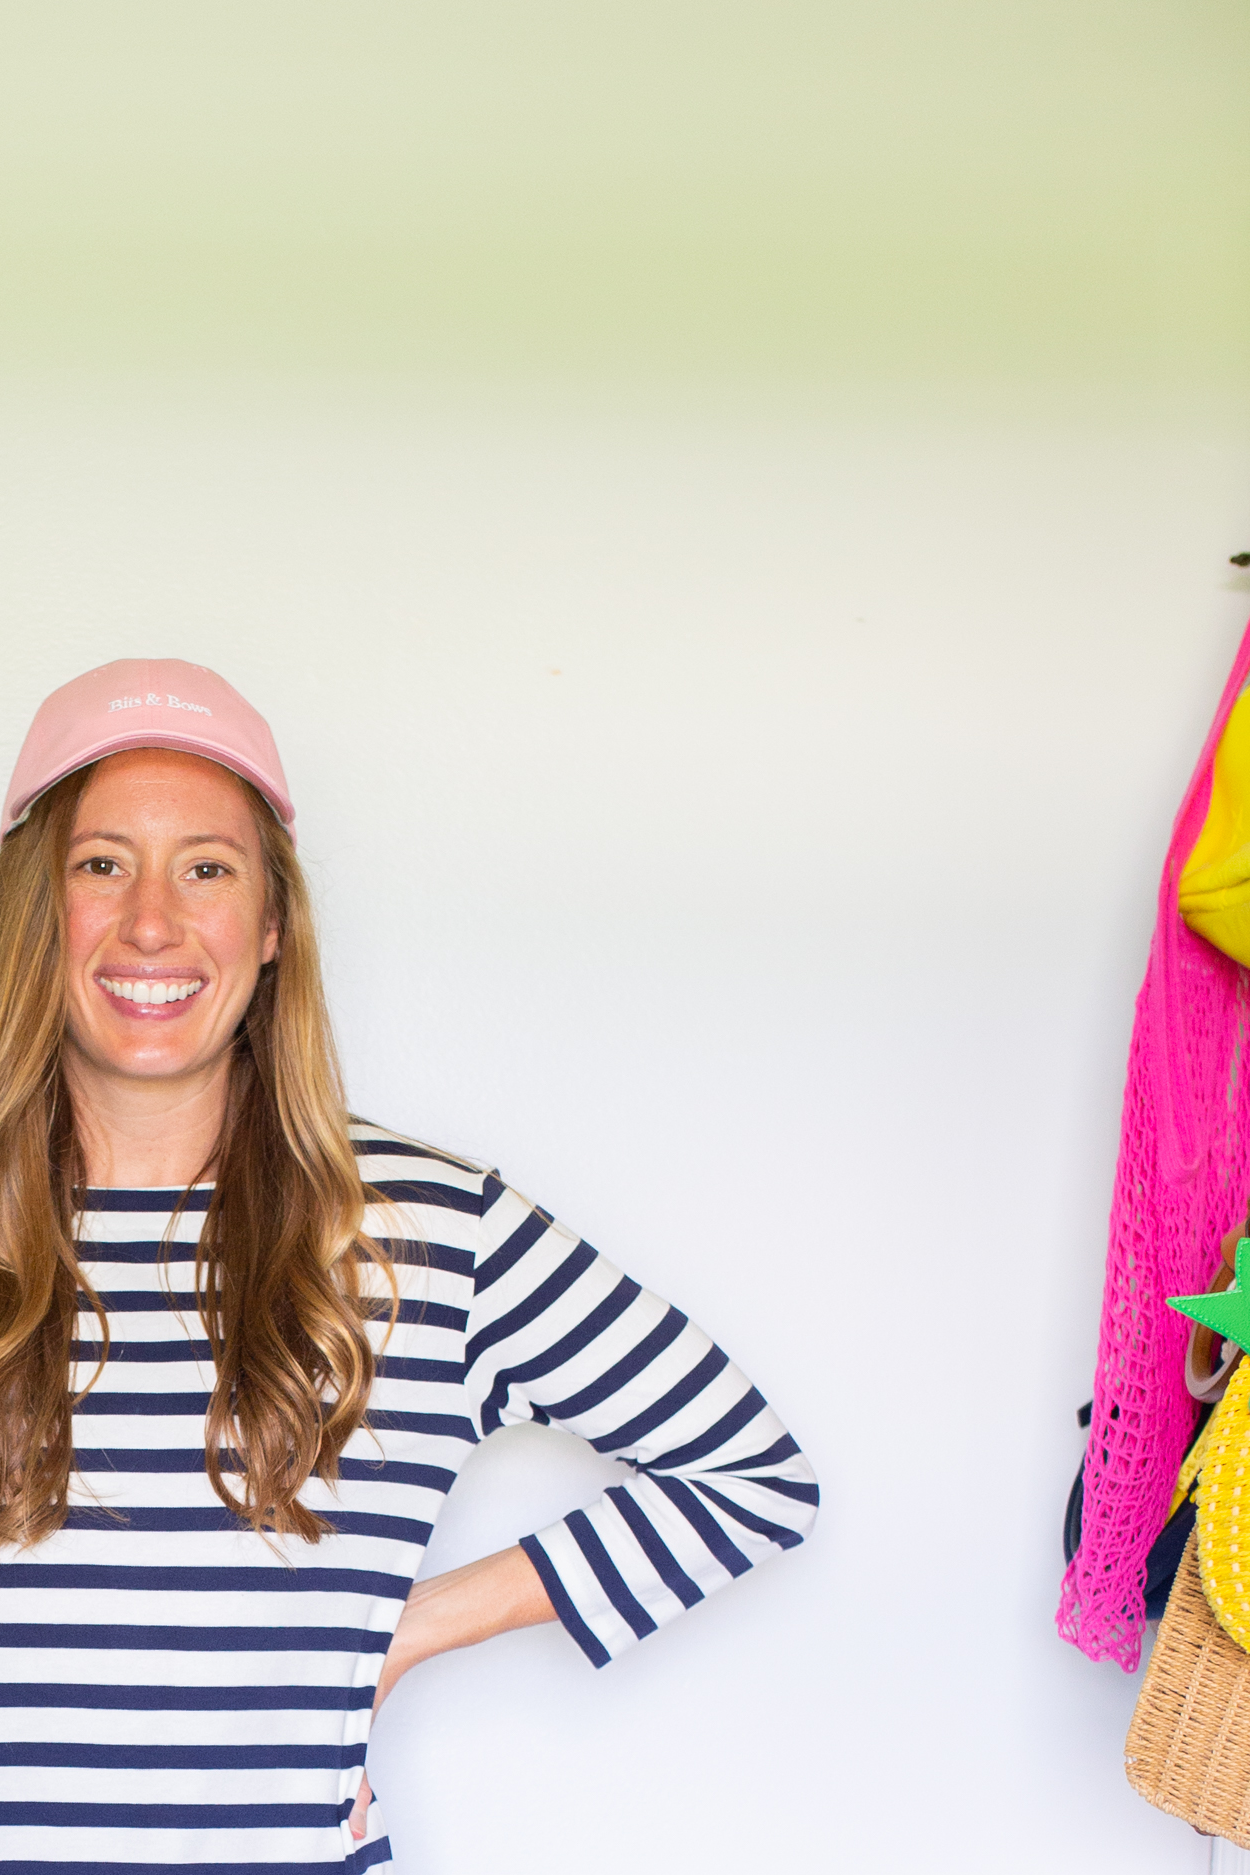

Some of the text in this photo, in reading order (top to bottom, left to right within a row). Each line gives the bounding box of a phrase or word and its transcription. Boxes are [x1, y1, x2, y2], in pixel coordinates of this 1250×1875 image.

[108, 692, 212, 717] Bits & Bows
